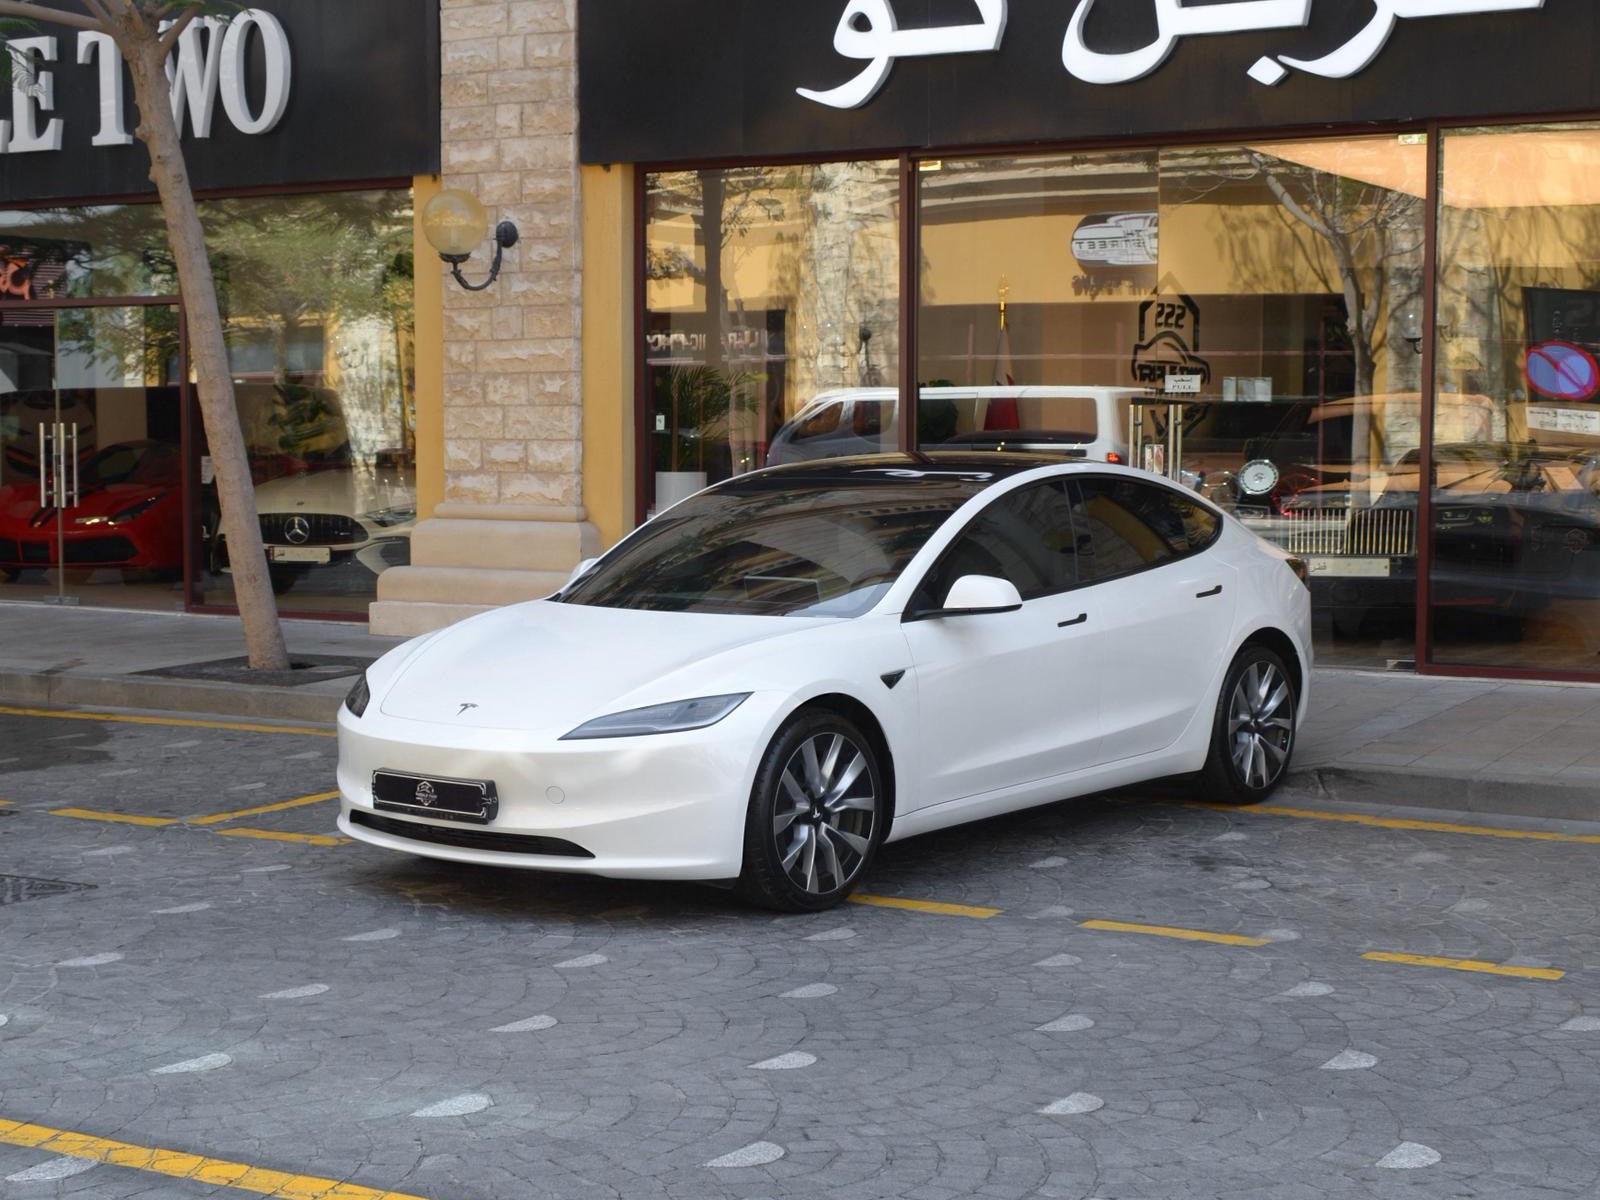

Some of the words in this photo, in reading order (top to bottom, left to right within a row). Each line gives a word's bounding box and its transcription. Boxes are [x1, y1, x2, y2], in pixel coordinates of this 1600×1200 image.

[0, 36, 64, 153] E
[77, 8, 292, 146] TWO
[1155, 303, 1186, 329] 222
